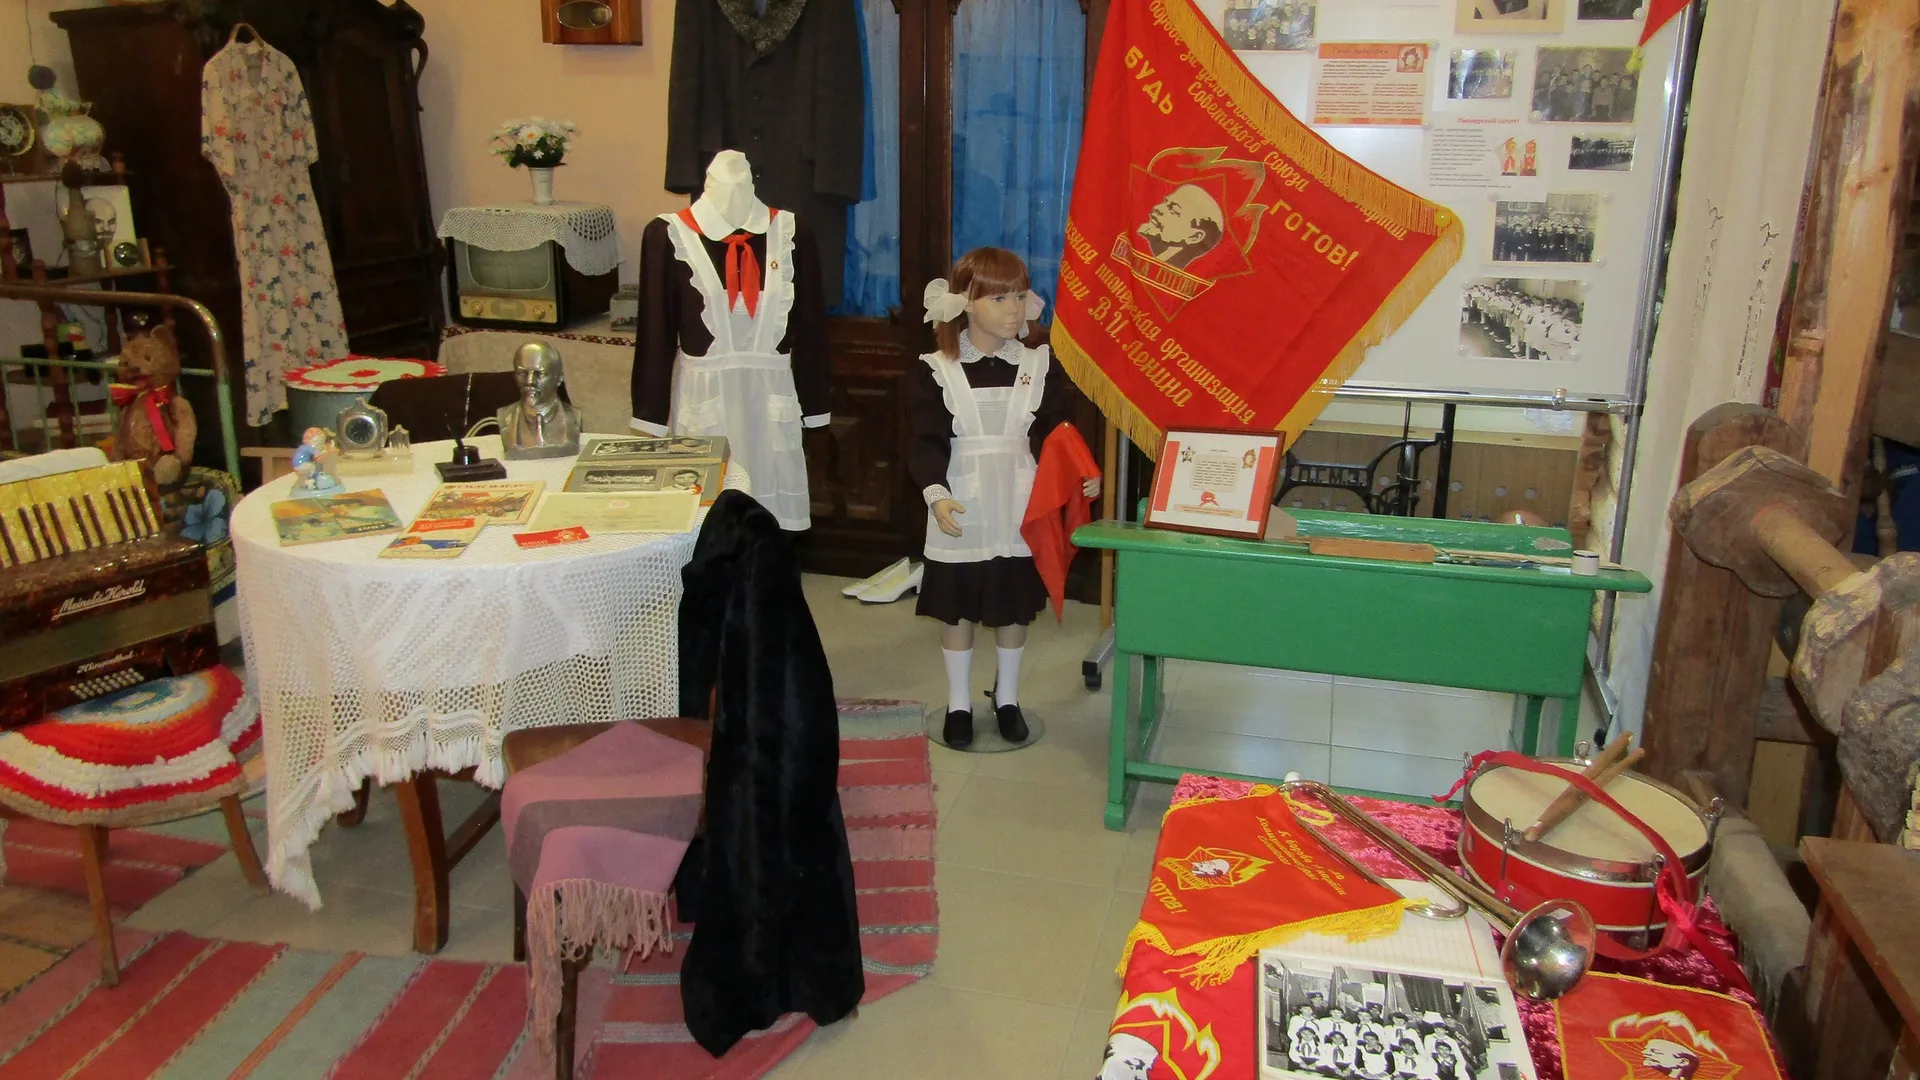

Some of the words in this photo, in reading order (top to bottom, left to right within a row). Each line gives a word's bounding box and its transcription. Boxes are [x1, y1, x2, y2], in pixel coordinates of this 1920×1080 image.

[1124, 45, 1174, 116] БУДЬ
[1187, 81, 1261, 153] Советского
[1263, 151, 1310, 193] Союза
[1269, 199, 1359, 271] ГОТОВ!
[1095, 262, 1162, 342] пионерская
[1160, 338, 1257, 425] организация
[1121, 340, 1194, 408] Ленина
